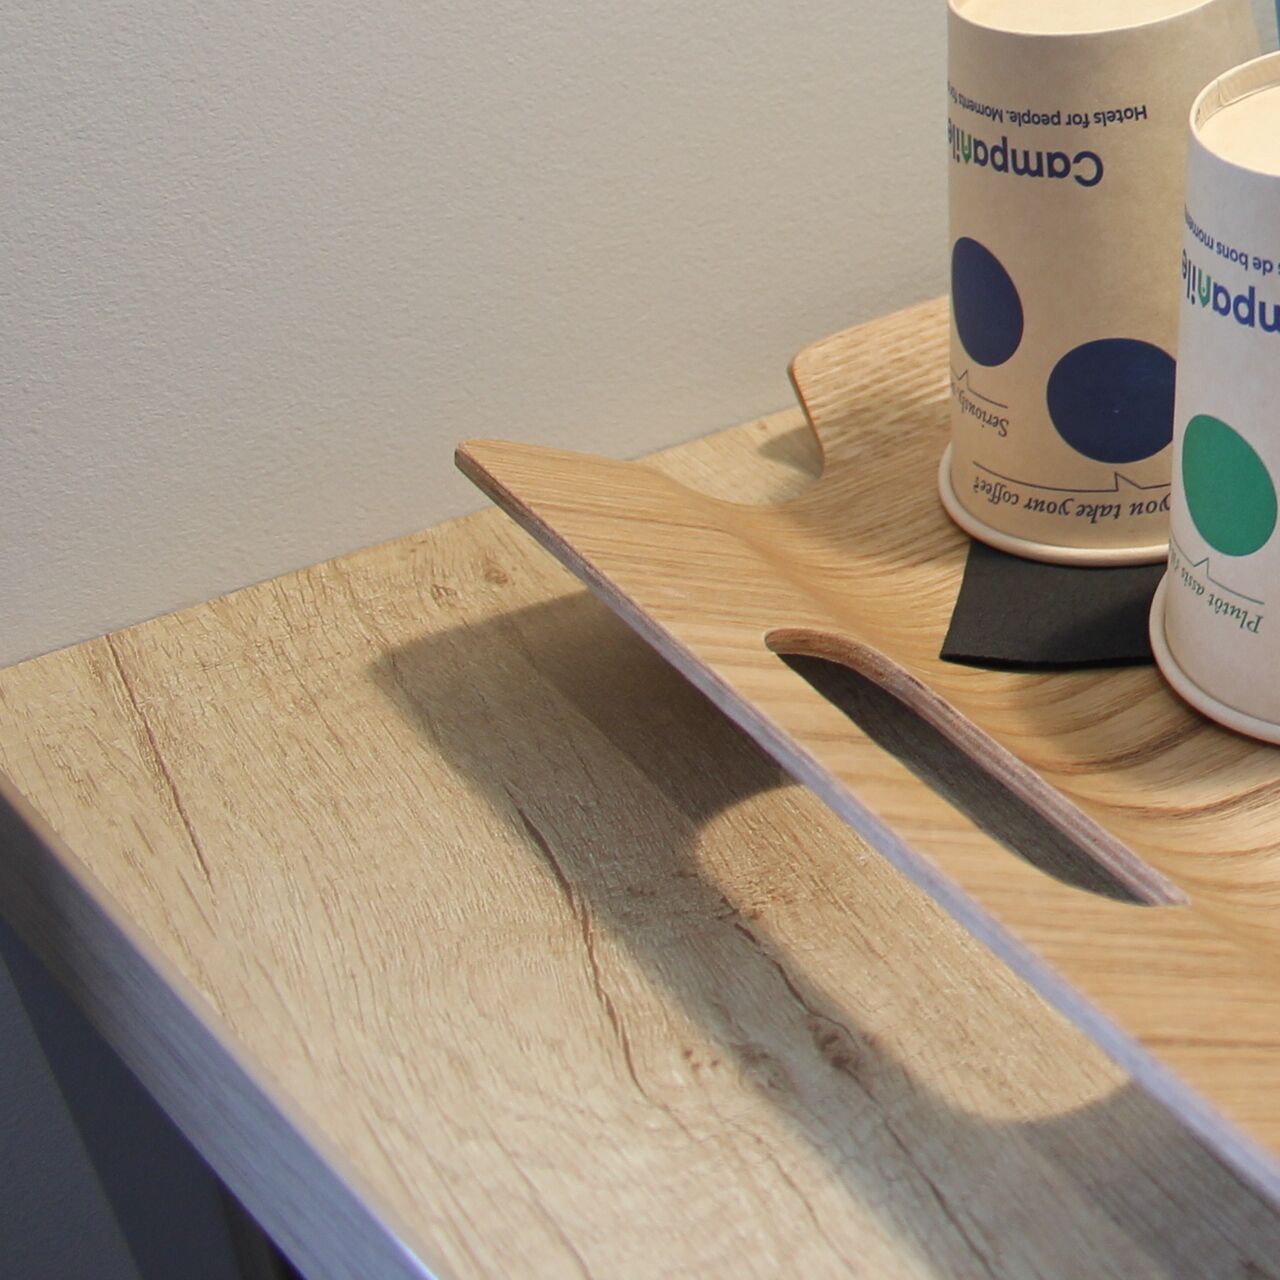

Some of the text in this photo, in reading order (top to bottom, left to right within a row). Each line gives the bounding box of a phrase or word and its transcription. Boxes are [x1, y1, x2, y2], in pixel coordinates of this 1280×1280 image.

[958, 93, 1003, 124] Moments
[1006, 110, 1061, 128] people.
[1065, 110, 1091, 129] for
[1094, 104, 1148, 128] Hotels
[1216, 241, 1249, 271] bons
[1252, 256, 1274, 276] de
[973, 476, 1171, 524] you take your coffee?
[1181, 567, 1264, 634] Plutôt assis
